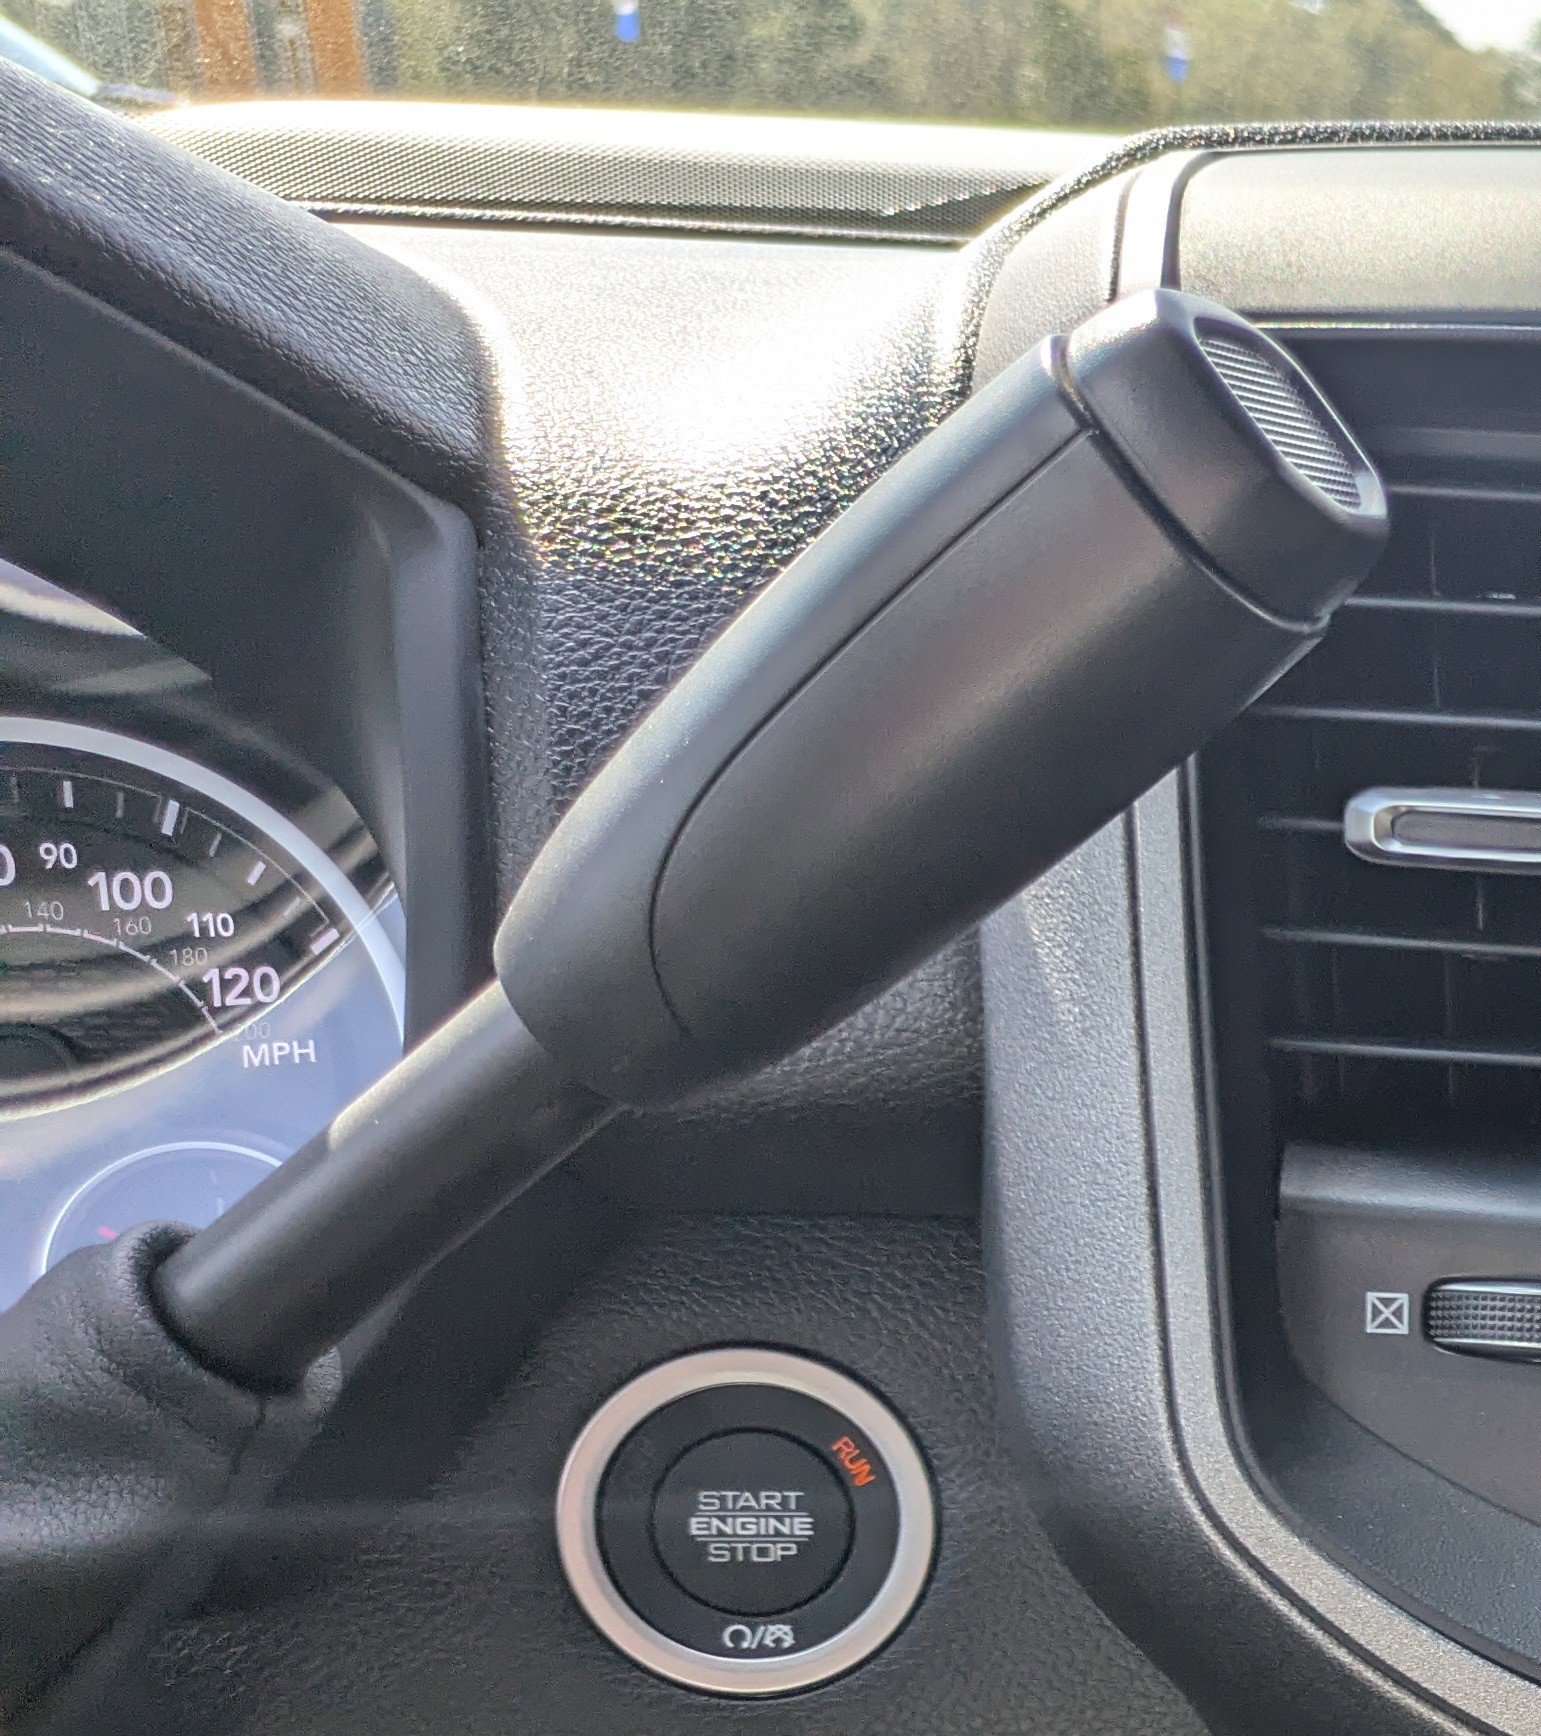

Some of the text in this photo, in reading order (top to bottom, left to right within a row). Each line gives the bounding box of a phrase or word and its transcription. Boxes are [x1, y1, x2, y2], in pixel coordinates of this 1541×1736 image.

[39, 842, 78, 870] 90
[87, 870, 173, 912] 100
[25, 901, 64, 921] 140
[113, 917, 152, 936] 160
[186, 912, 235, 939] 110
[171, 948, 208, 967] 180
[202, 965, 281, 1008] 120
[241, 1039, 316, 1069] MPH
[830, 1435, 877, 1487] RUN
[697, 1491, 805, 1510] START
[688, 1516, 815, 1536] ENGINE
[706, 1543, 798, 1562] STOP
